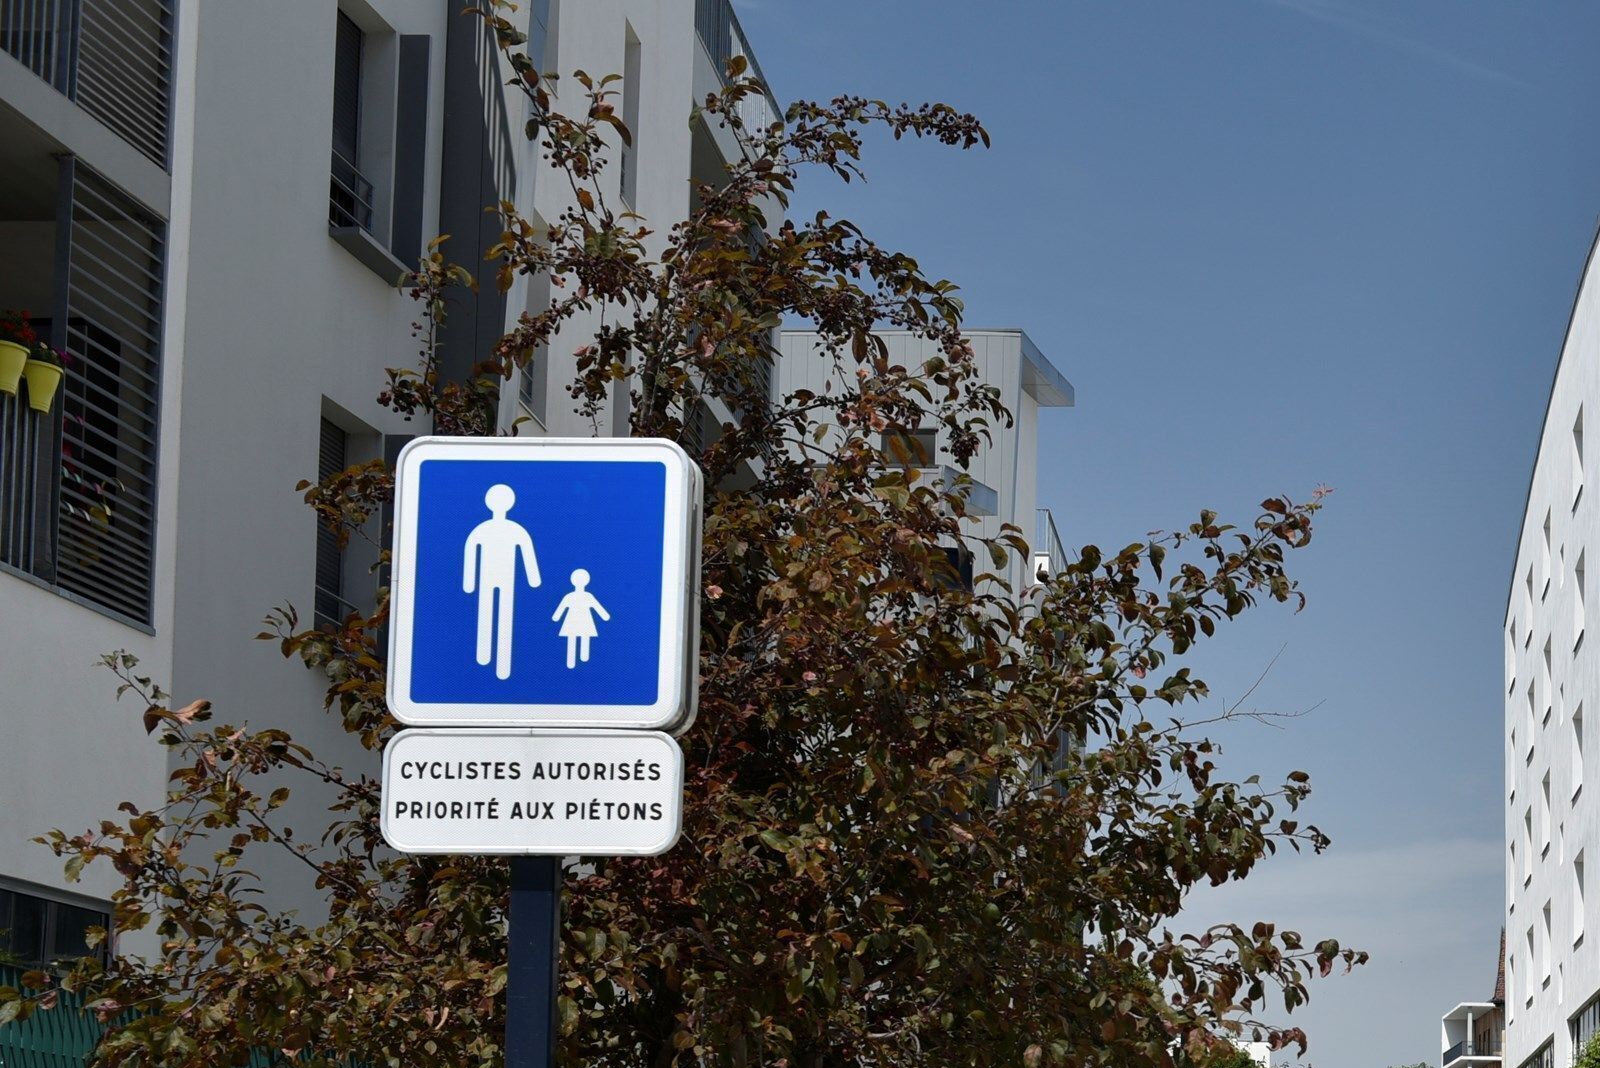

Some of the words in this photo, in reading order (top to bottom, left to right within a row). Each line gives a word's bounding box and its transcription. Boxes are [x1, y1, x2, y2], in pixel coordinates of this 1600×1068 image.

[400, 761, 521, 780] CYCLISTES
[532, 758, 661, 781] AUTORISÉS
[395, 797, 499, 820] PRIORITÉ
[510, 801, 555, 820] AUX
[565, 798, 663, 821] PIÉTONS
